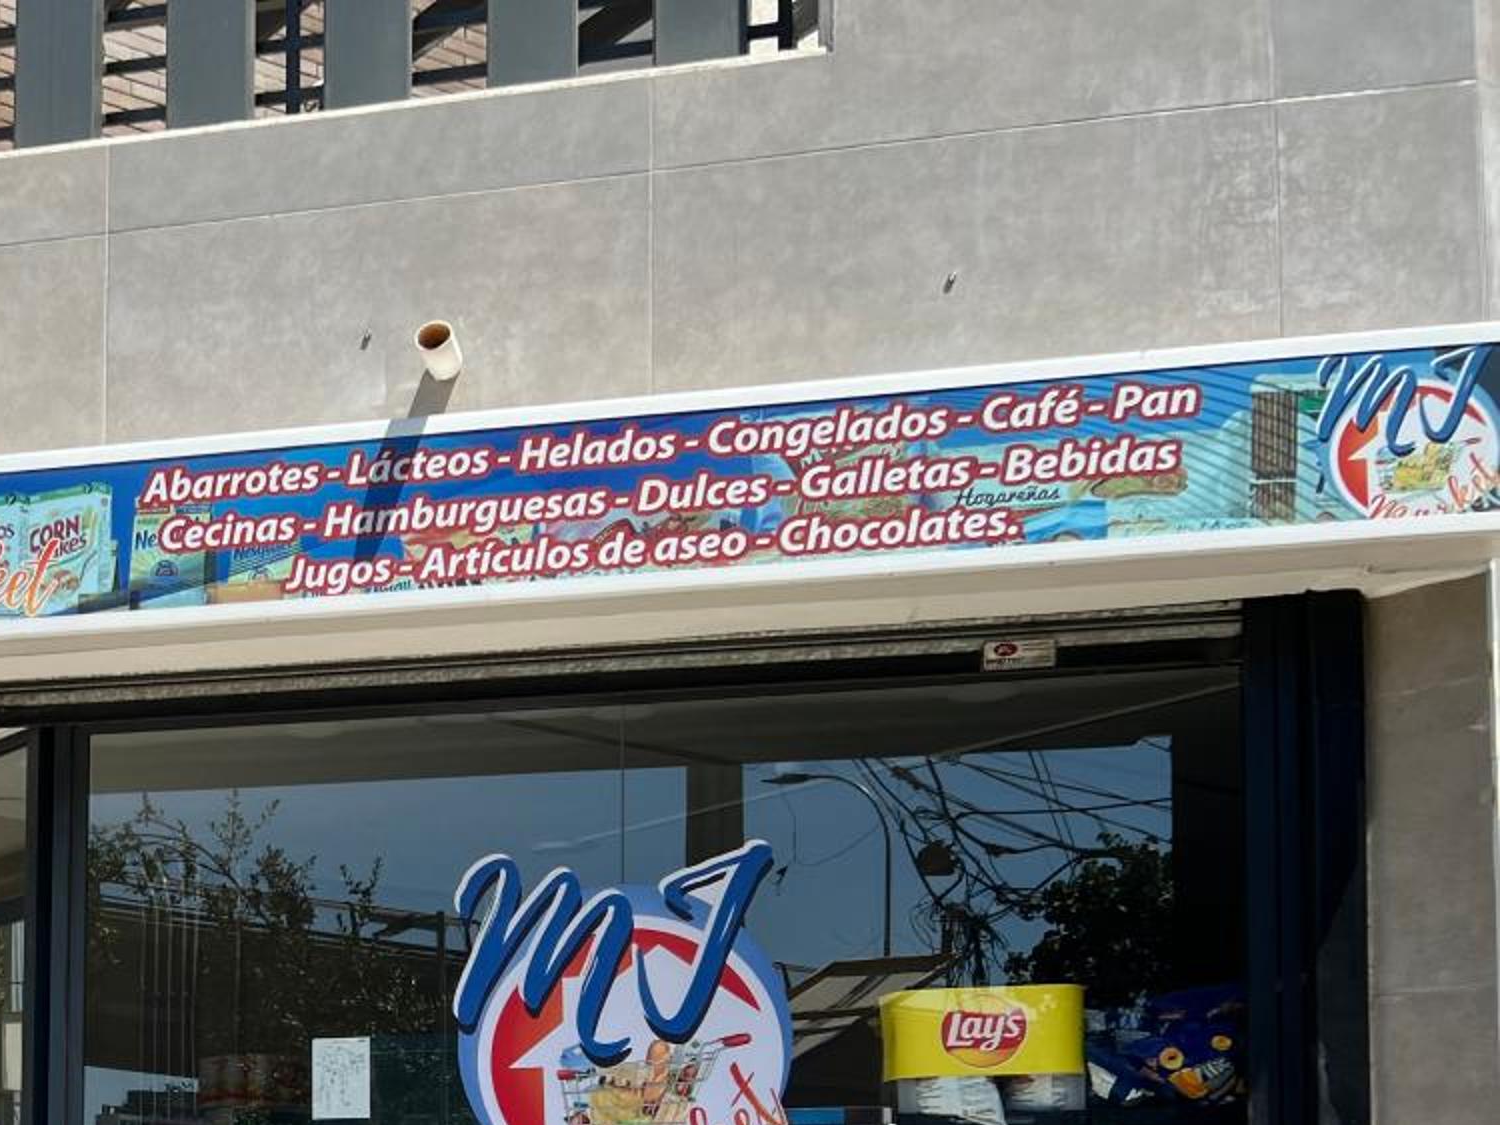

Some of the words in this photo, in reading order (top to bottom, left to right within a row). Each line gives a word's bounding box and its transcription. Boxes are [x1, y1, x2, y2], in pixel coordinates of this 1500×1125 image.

[143, 463, 320, 503] Abarrotes
[348, 448, 489, 486] Lácteos
[519, 428, 675, 472] Helados
[709, 404, 948, 457] Congelados
[982, 386, 1080, 430] Café
[1111, 384, 1198, 421] Pan
[29, 515, 80, 553] CORN
[161, 515, 295, 550] Cecinas
[324, 492, 607, 537] Hamburguesas
[638, 473, 768, 512] Dulces
[801, 458, 970, 497] Galletas
[1004, 438, 1178, 482] Bebidas
[954, 484, 1061, 508] Hogareñas
[285, 555, 391, 594] Jugos
[420, 536, 589, 580] Artículos
[598, 531, 645, 565] de
[654, 531, 748, 562] aseo
[779, 508, 1019, 551] Chocolates.
[453, 839, 774, 1068] MJ
[945, 1008, 1023, 1051] Lay's
